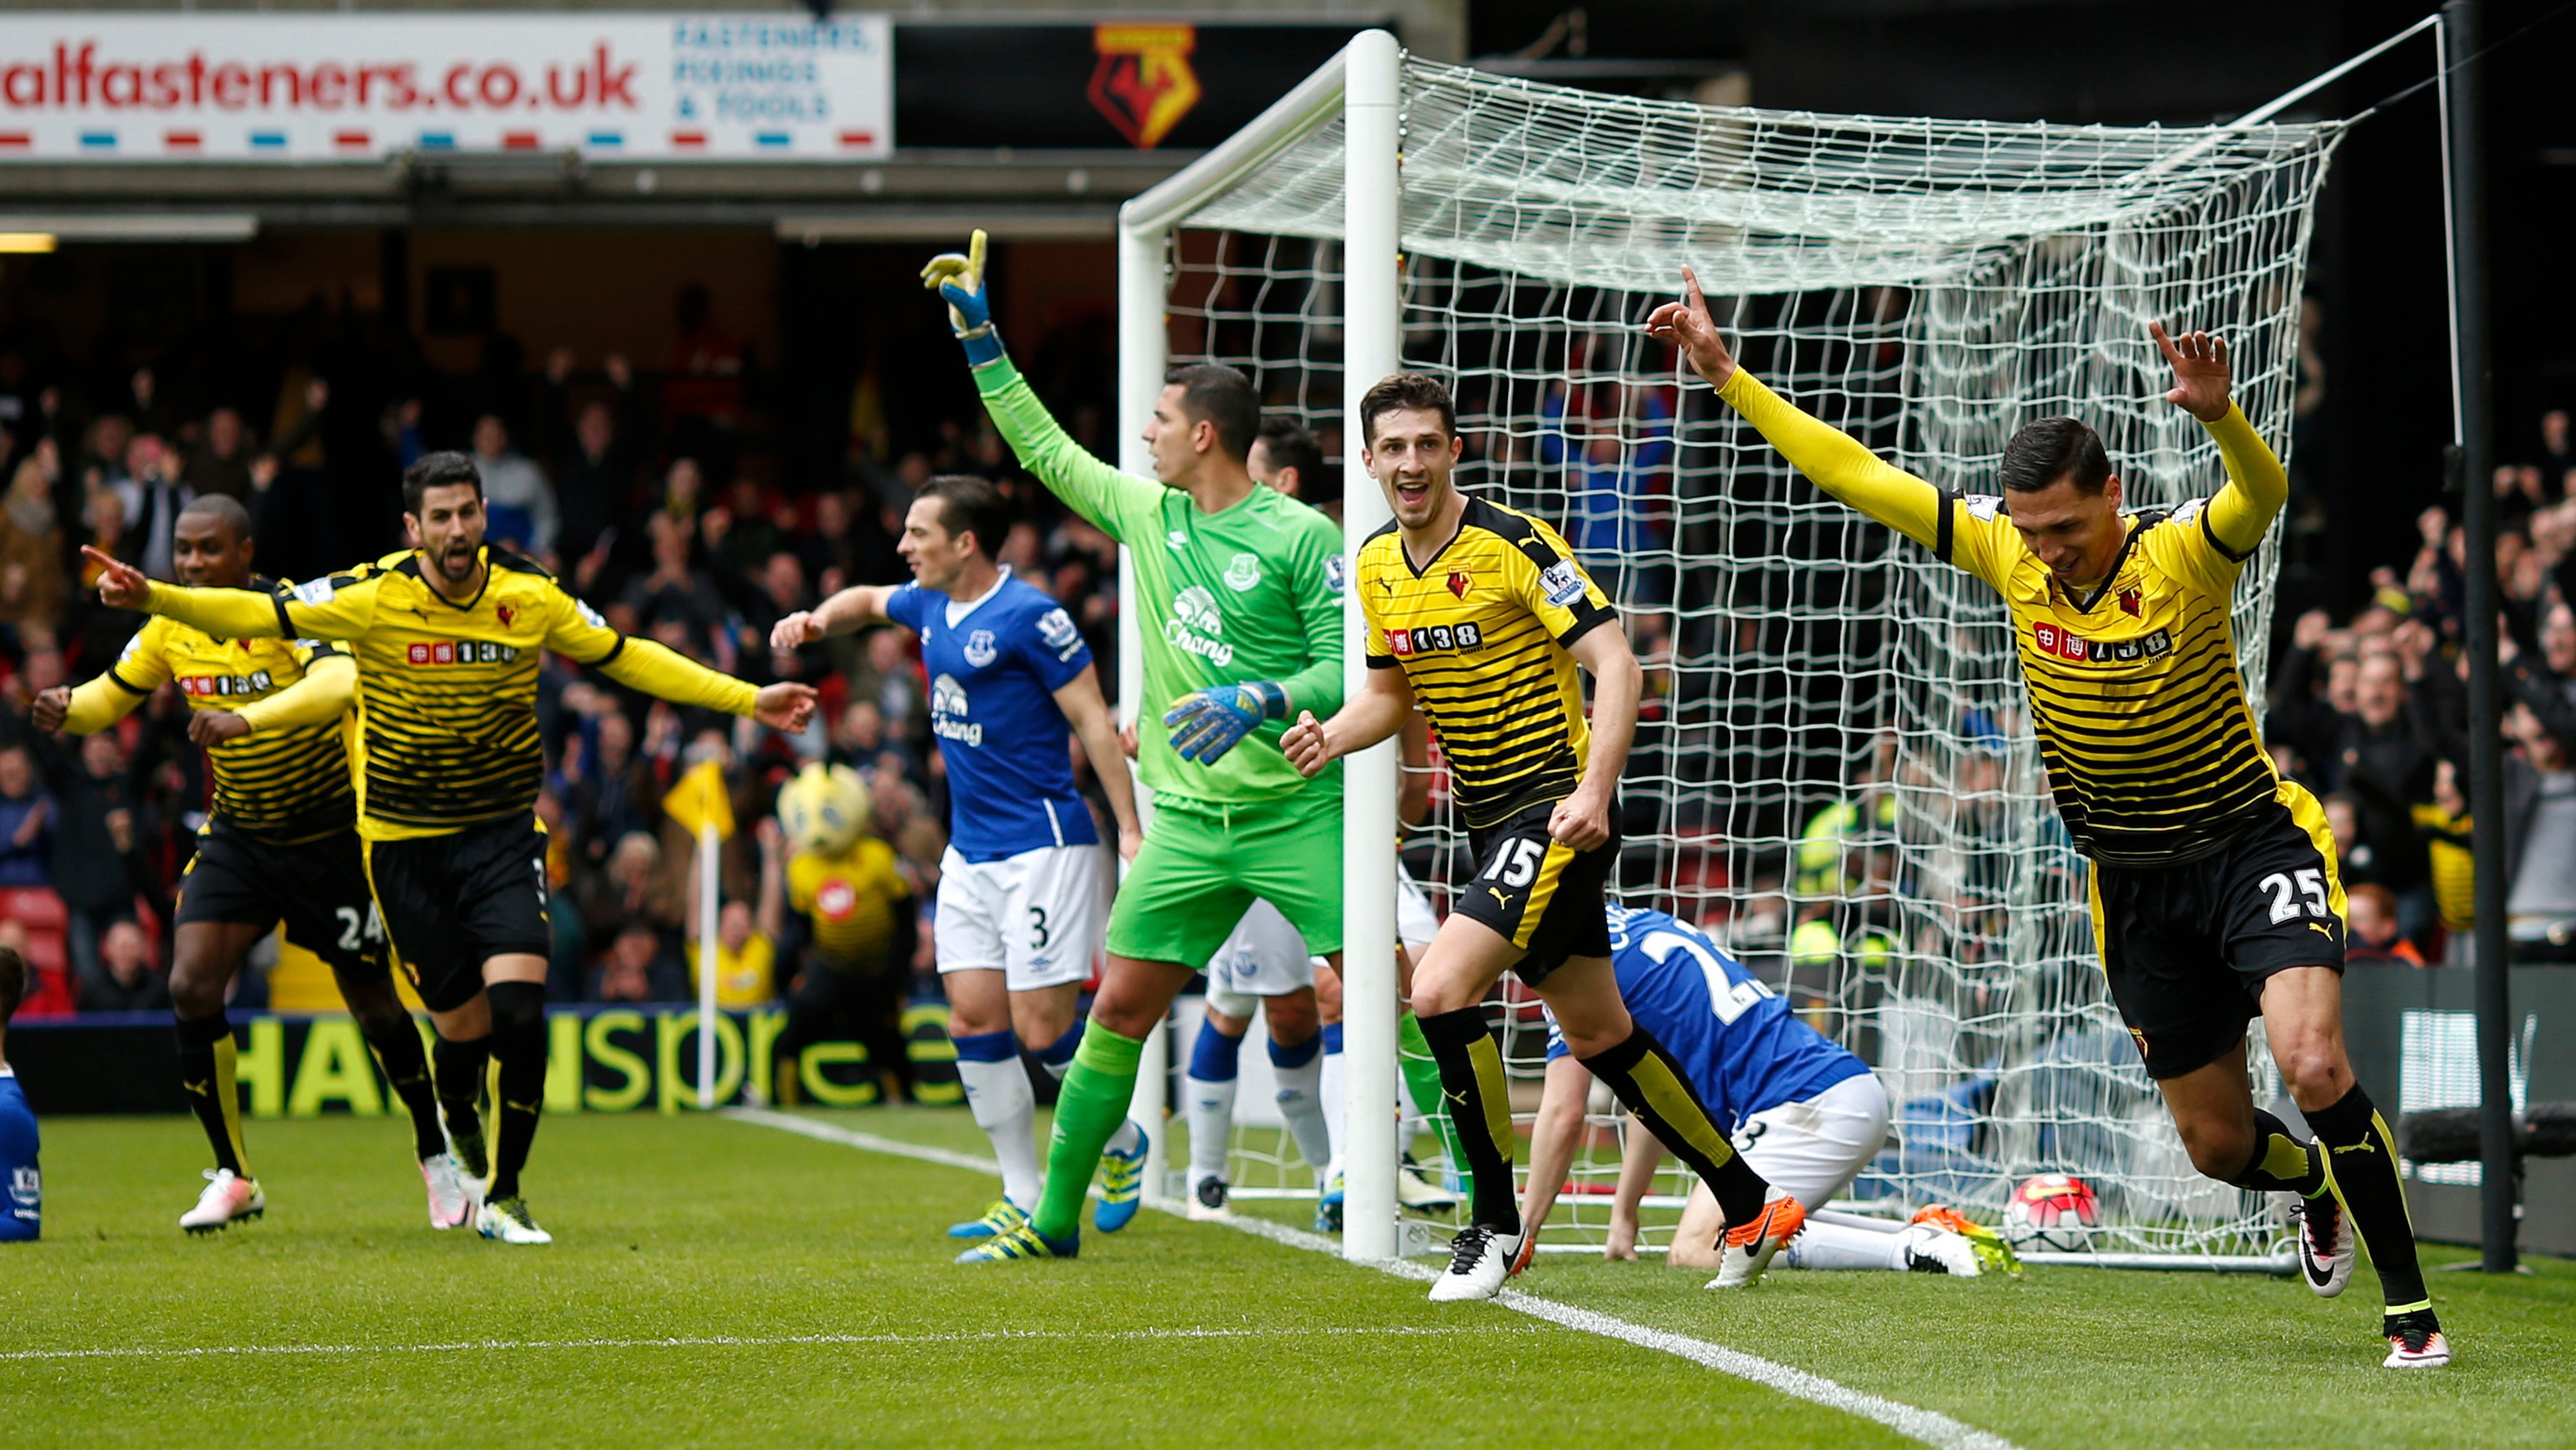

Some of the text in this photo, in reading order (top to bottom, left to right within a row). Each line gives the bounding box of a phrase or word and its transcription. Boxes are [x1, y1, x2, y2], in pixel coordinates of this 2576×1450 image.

[0, 41, 638, 111] alfasteners.co.uk
[1166, 619, 1234, 667] Chang
[1482, 837, 1544, 887] 15
[2259, 868, 2327, 924] 25
[336, 899, 383, 950] 24
[1029, 907, 1048, 949] 3
